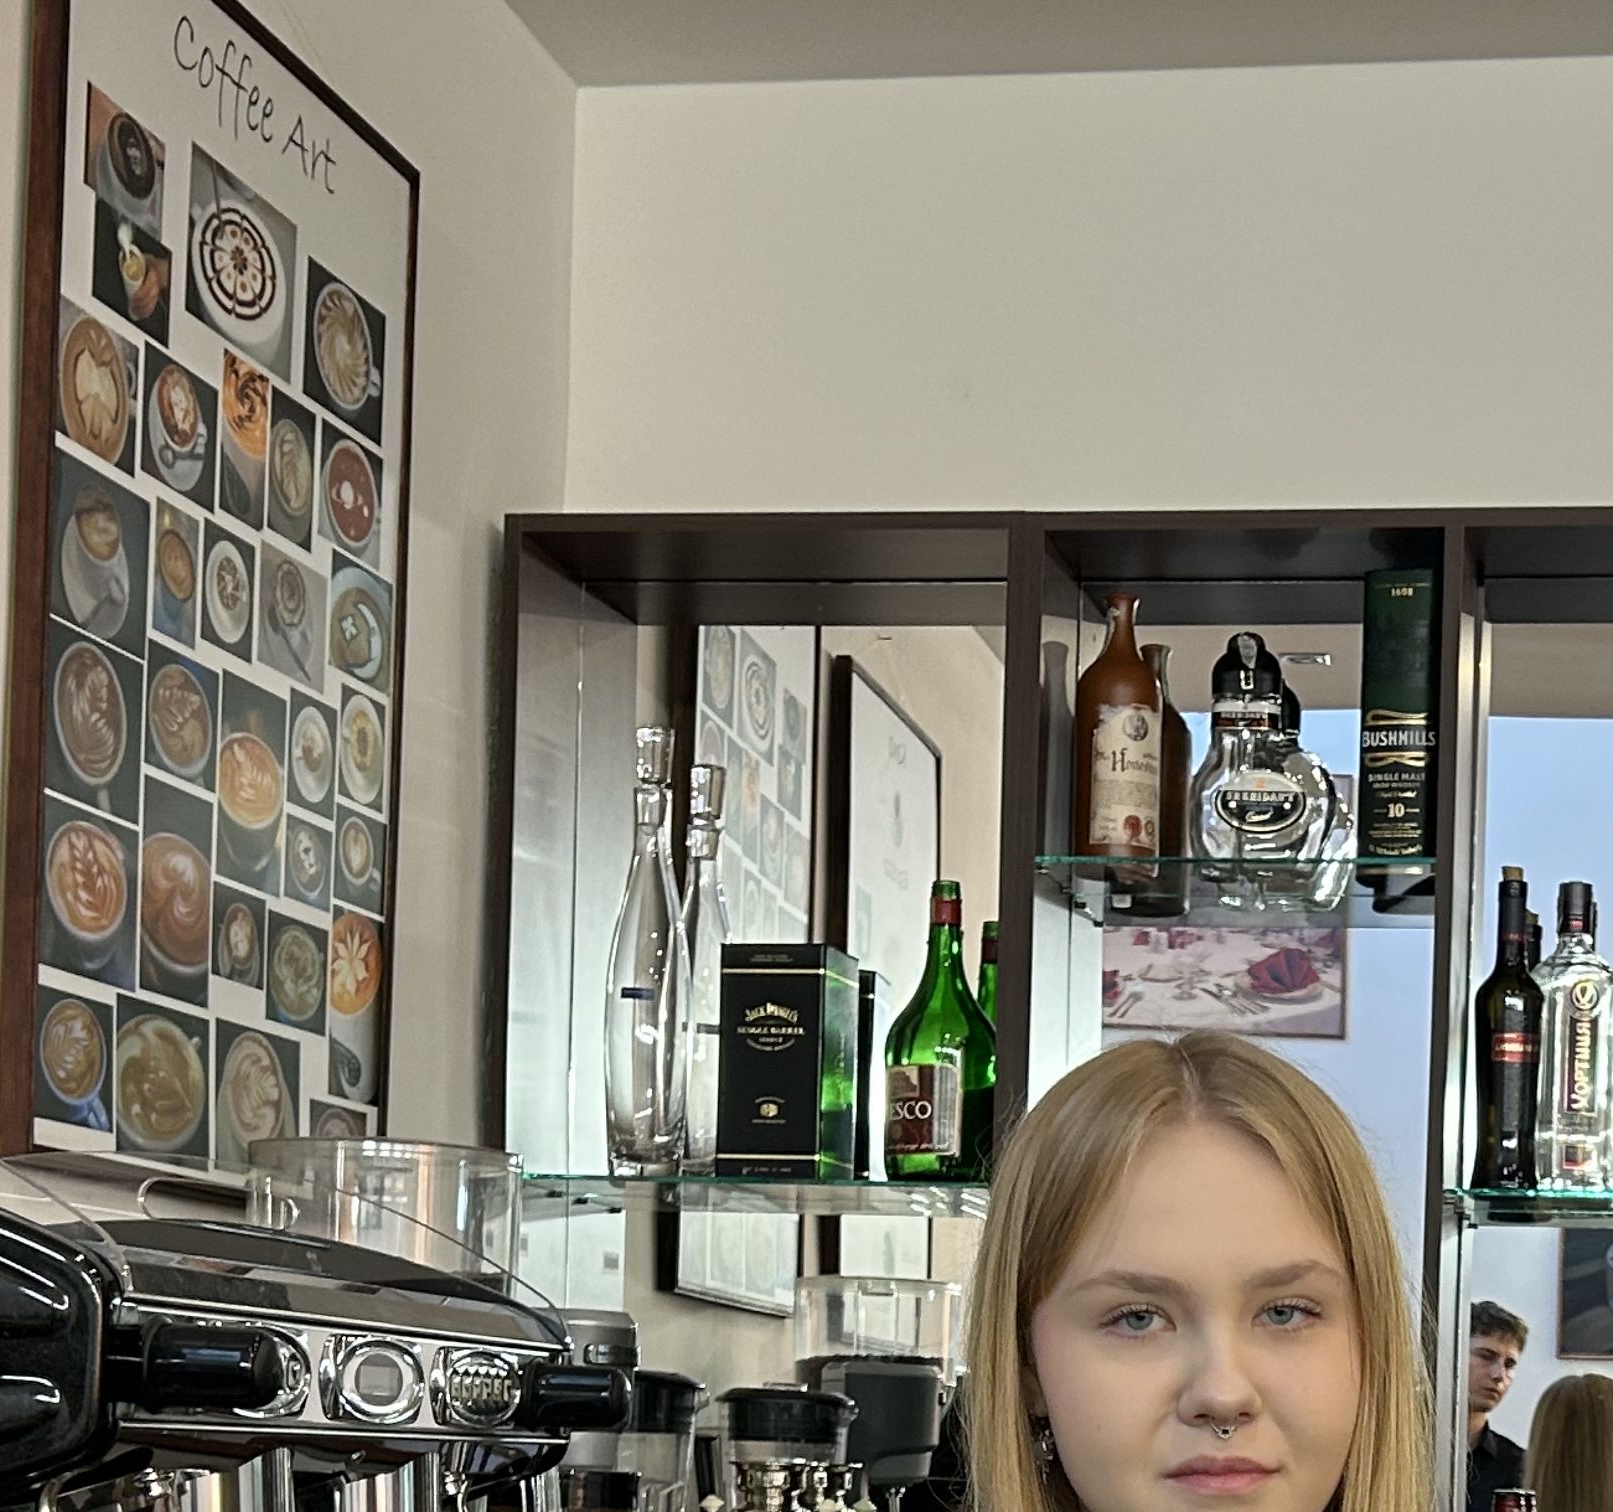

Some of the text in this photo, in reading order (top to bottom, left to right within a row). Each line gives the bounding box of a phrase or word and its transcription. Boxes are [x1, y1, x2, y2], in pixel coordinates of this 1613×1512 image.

[174, 15, 336, 194] Coffee Art
[1363, 730, 1436, 748] BUSHMILLS
[1388, 804, 1404, 817] 10
